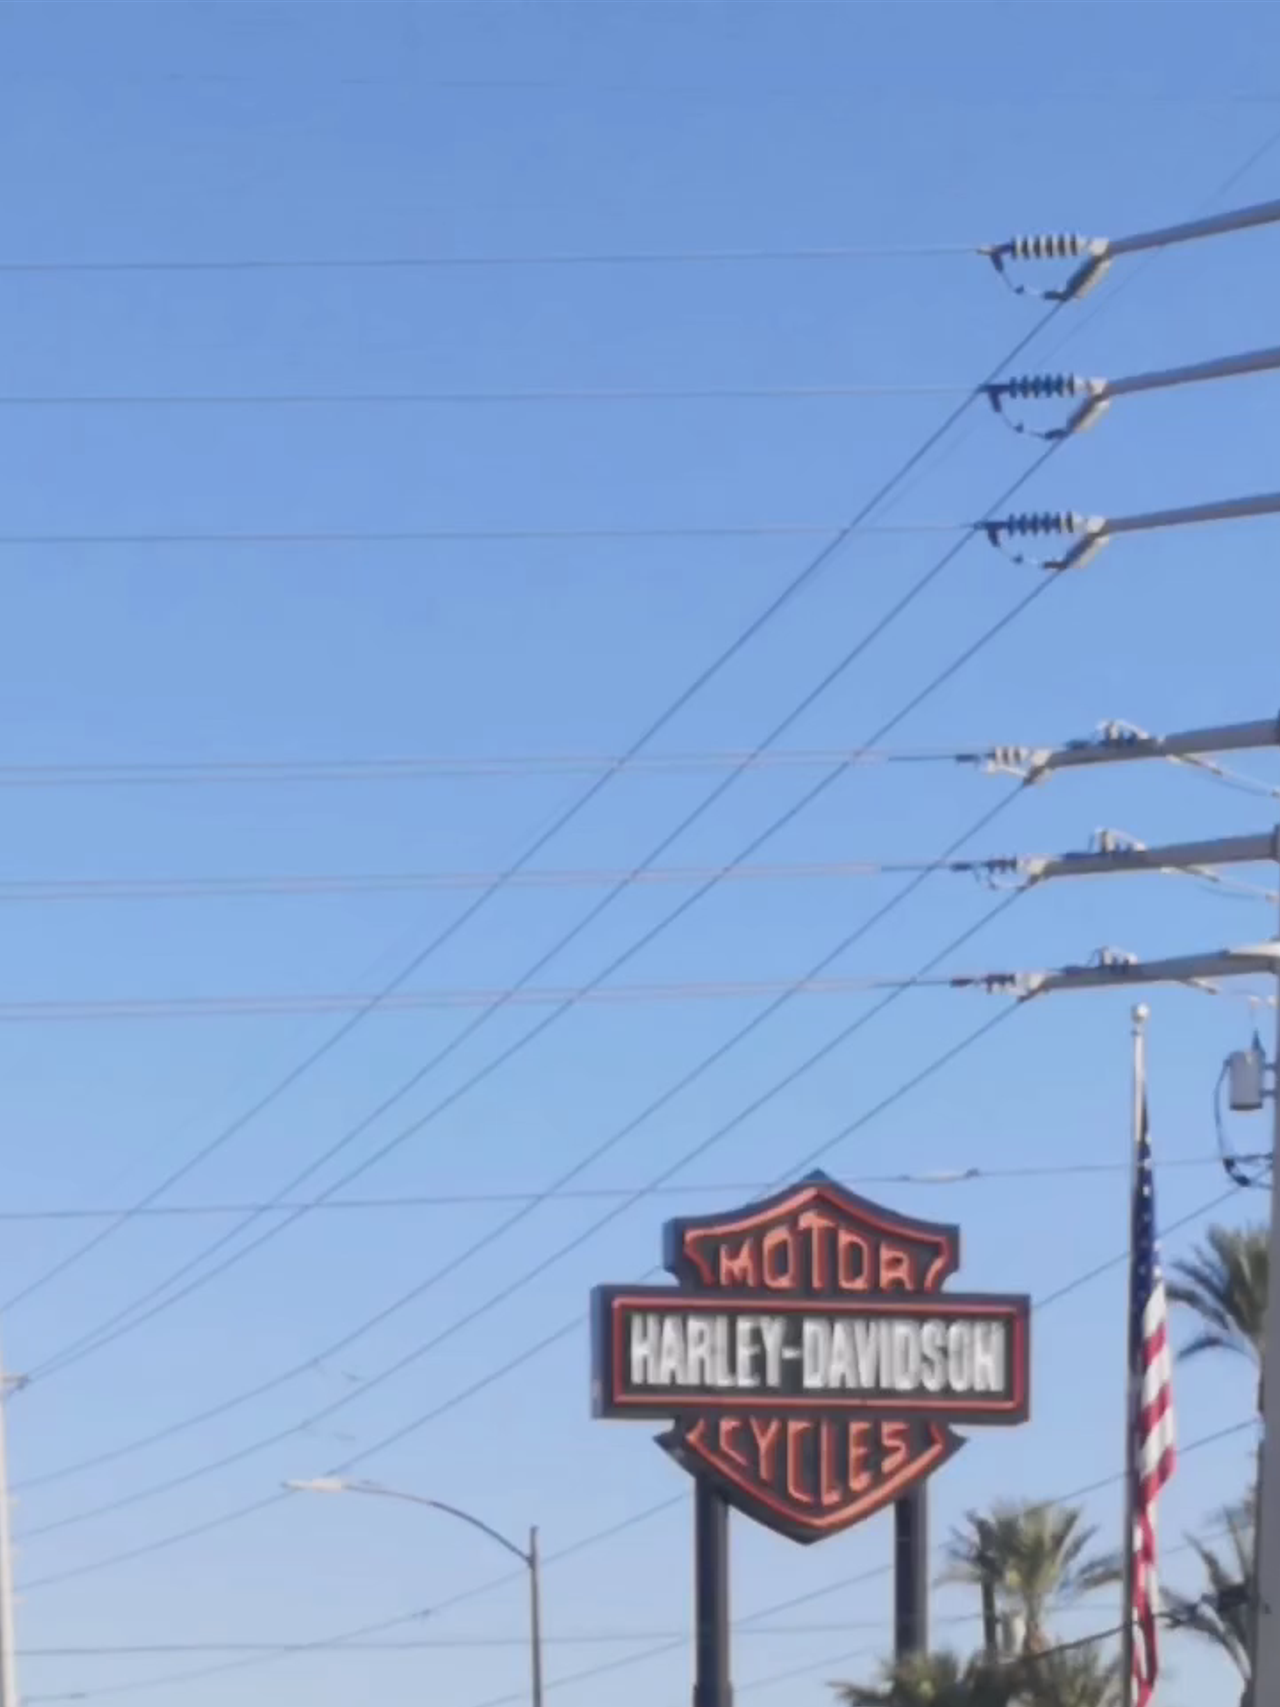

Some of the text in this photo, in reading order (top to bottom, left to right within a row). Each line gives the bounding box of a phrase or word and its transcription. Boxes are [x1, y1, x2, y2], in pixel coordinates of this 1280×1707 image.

[719, 1209, 914, 1292] MOTOR
[630, 1313, 1006, 1393] HARLEY-DAVIDSON
[719, 1418, 911, 1506] CYCLES
